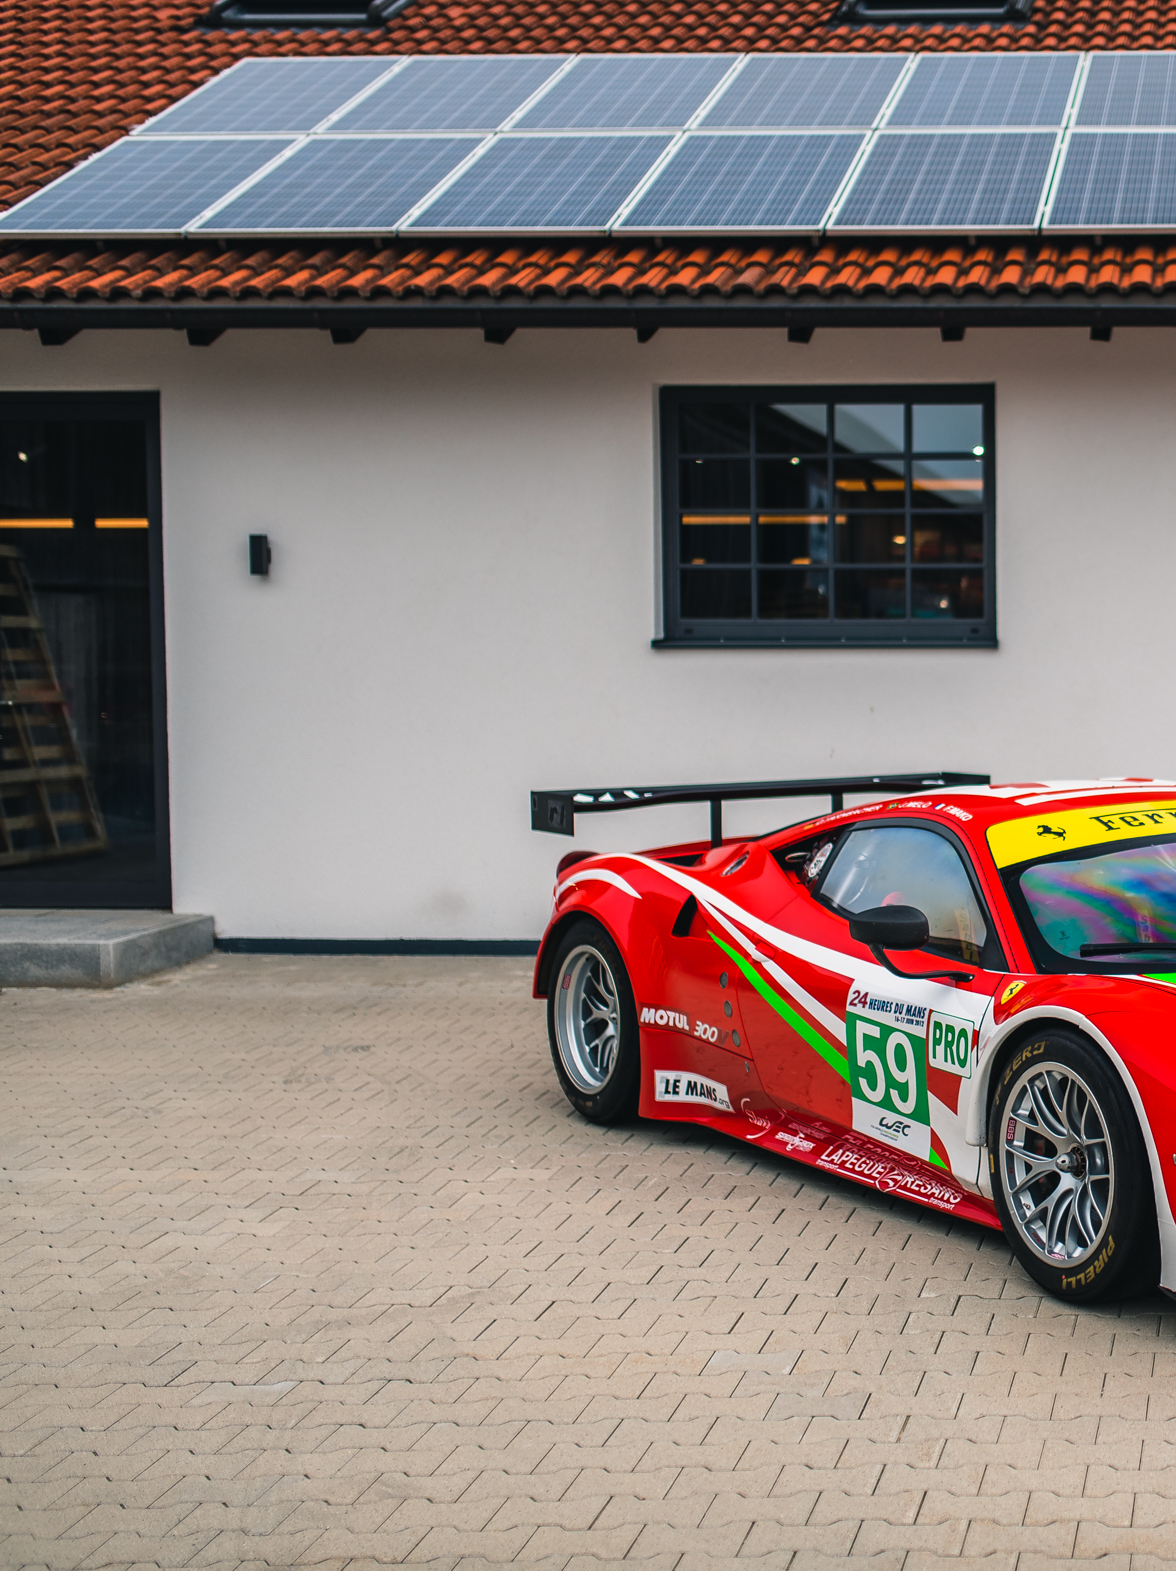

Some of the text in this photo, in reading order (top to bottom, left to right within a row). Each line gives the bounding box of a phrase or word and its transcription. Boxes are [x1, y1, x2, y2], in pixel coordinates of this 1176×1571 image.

[849, 989, 927, 1019] 24 HEURES DU MANS
[640, 1007, 689, 1031] MOTUL
[914, 1019, 925, 1028] 2012
[932, 1020, 969, 1069] PRO
[855, 1019, 917, 1114] 59
[664, 1078, 681, 1095] LE
[878, 1116, 911, 1137] WEC
[820, 1145, 885, 1178] LAPEGUE
[928, 1196, 955, 1210] transport
[1062, 1235, 1115, 1290] PIRELLI
